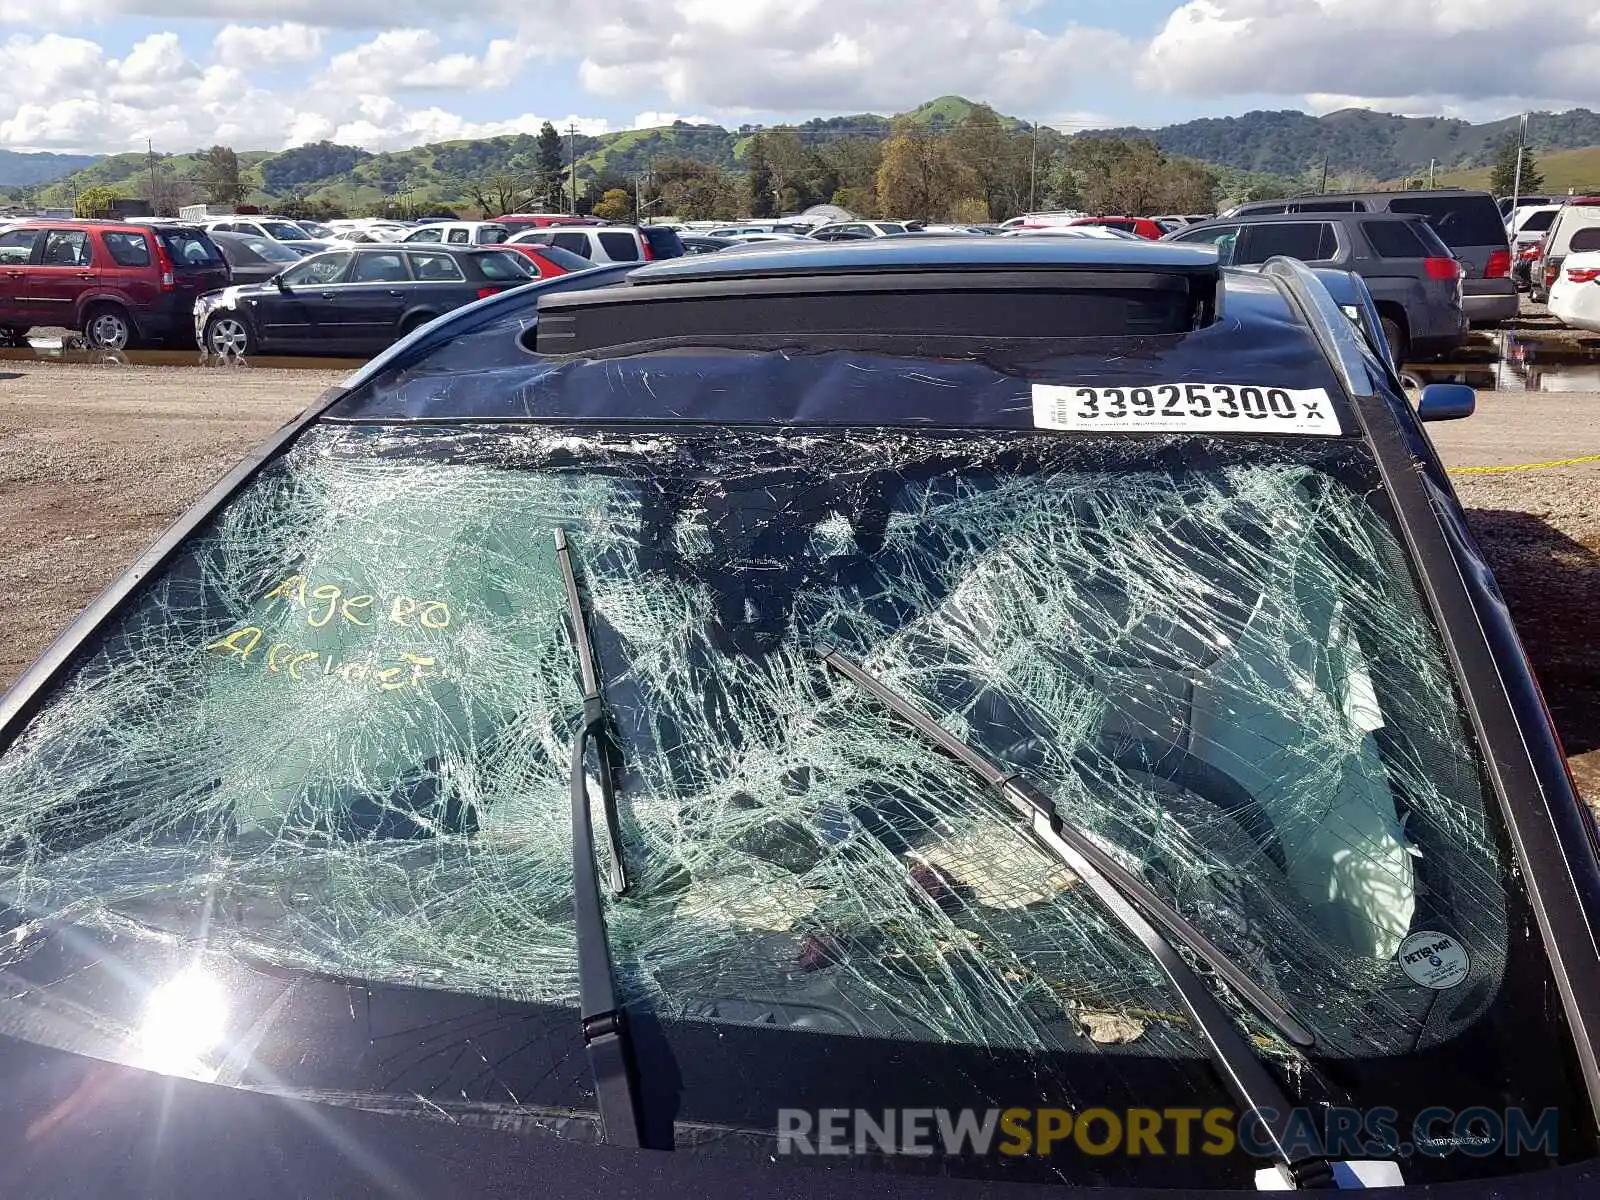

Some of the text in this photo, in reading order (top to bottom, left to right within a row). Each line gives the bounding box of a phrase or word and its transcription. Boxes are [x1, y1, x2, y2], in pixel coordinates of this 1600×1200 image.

[1076, 384, 1297, 420] 33925300
[1403, 946, 1434, 964] PETER
[1432, 938, 1452, 953] PAN
